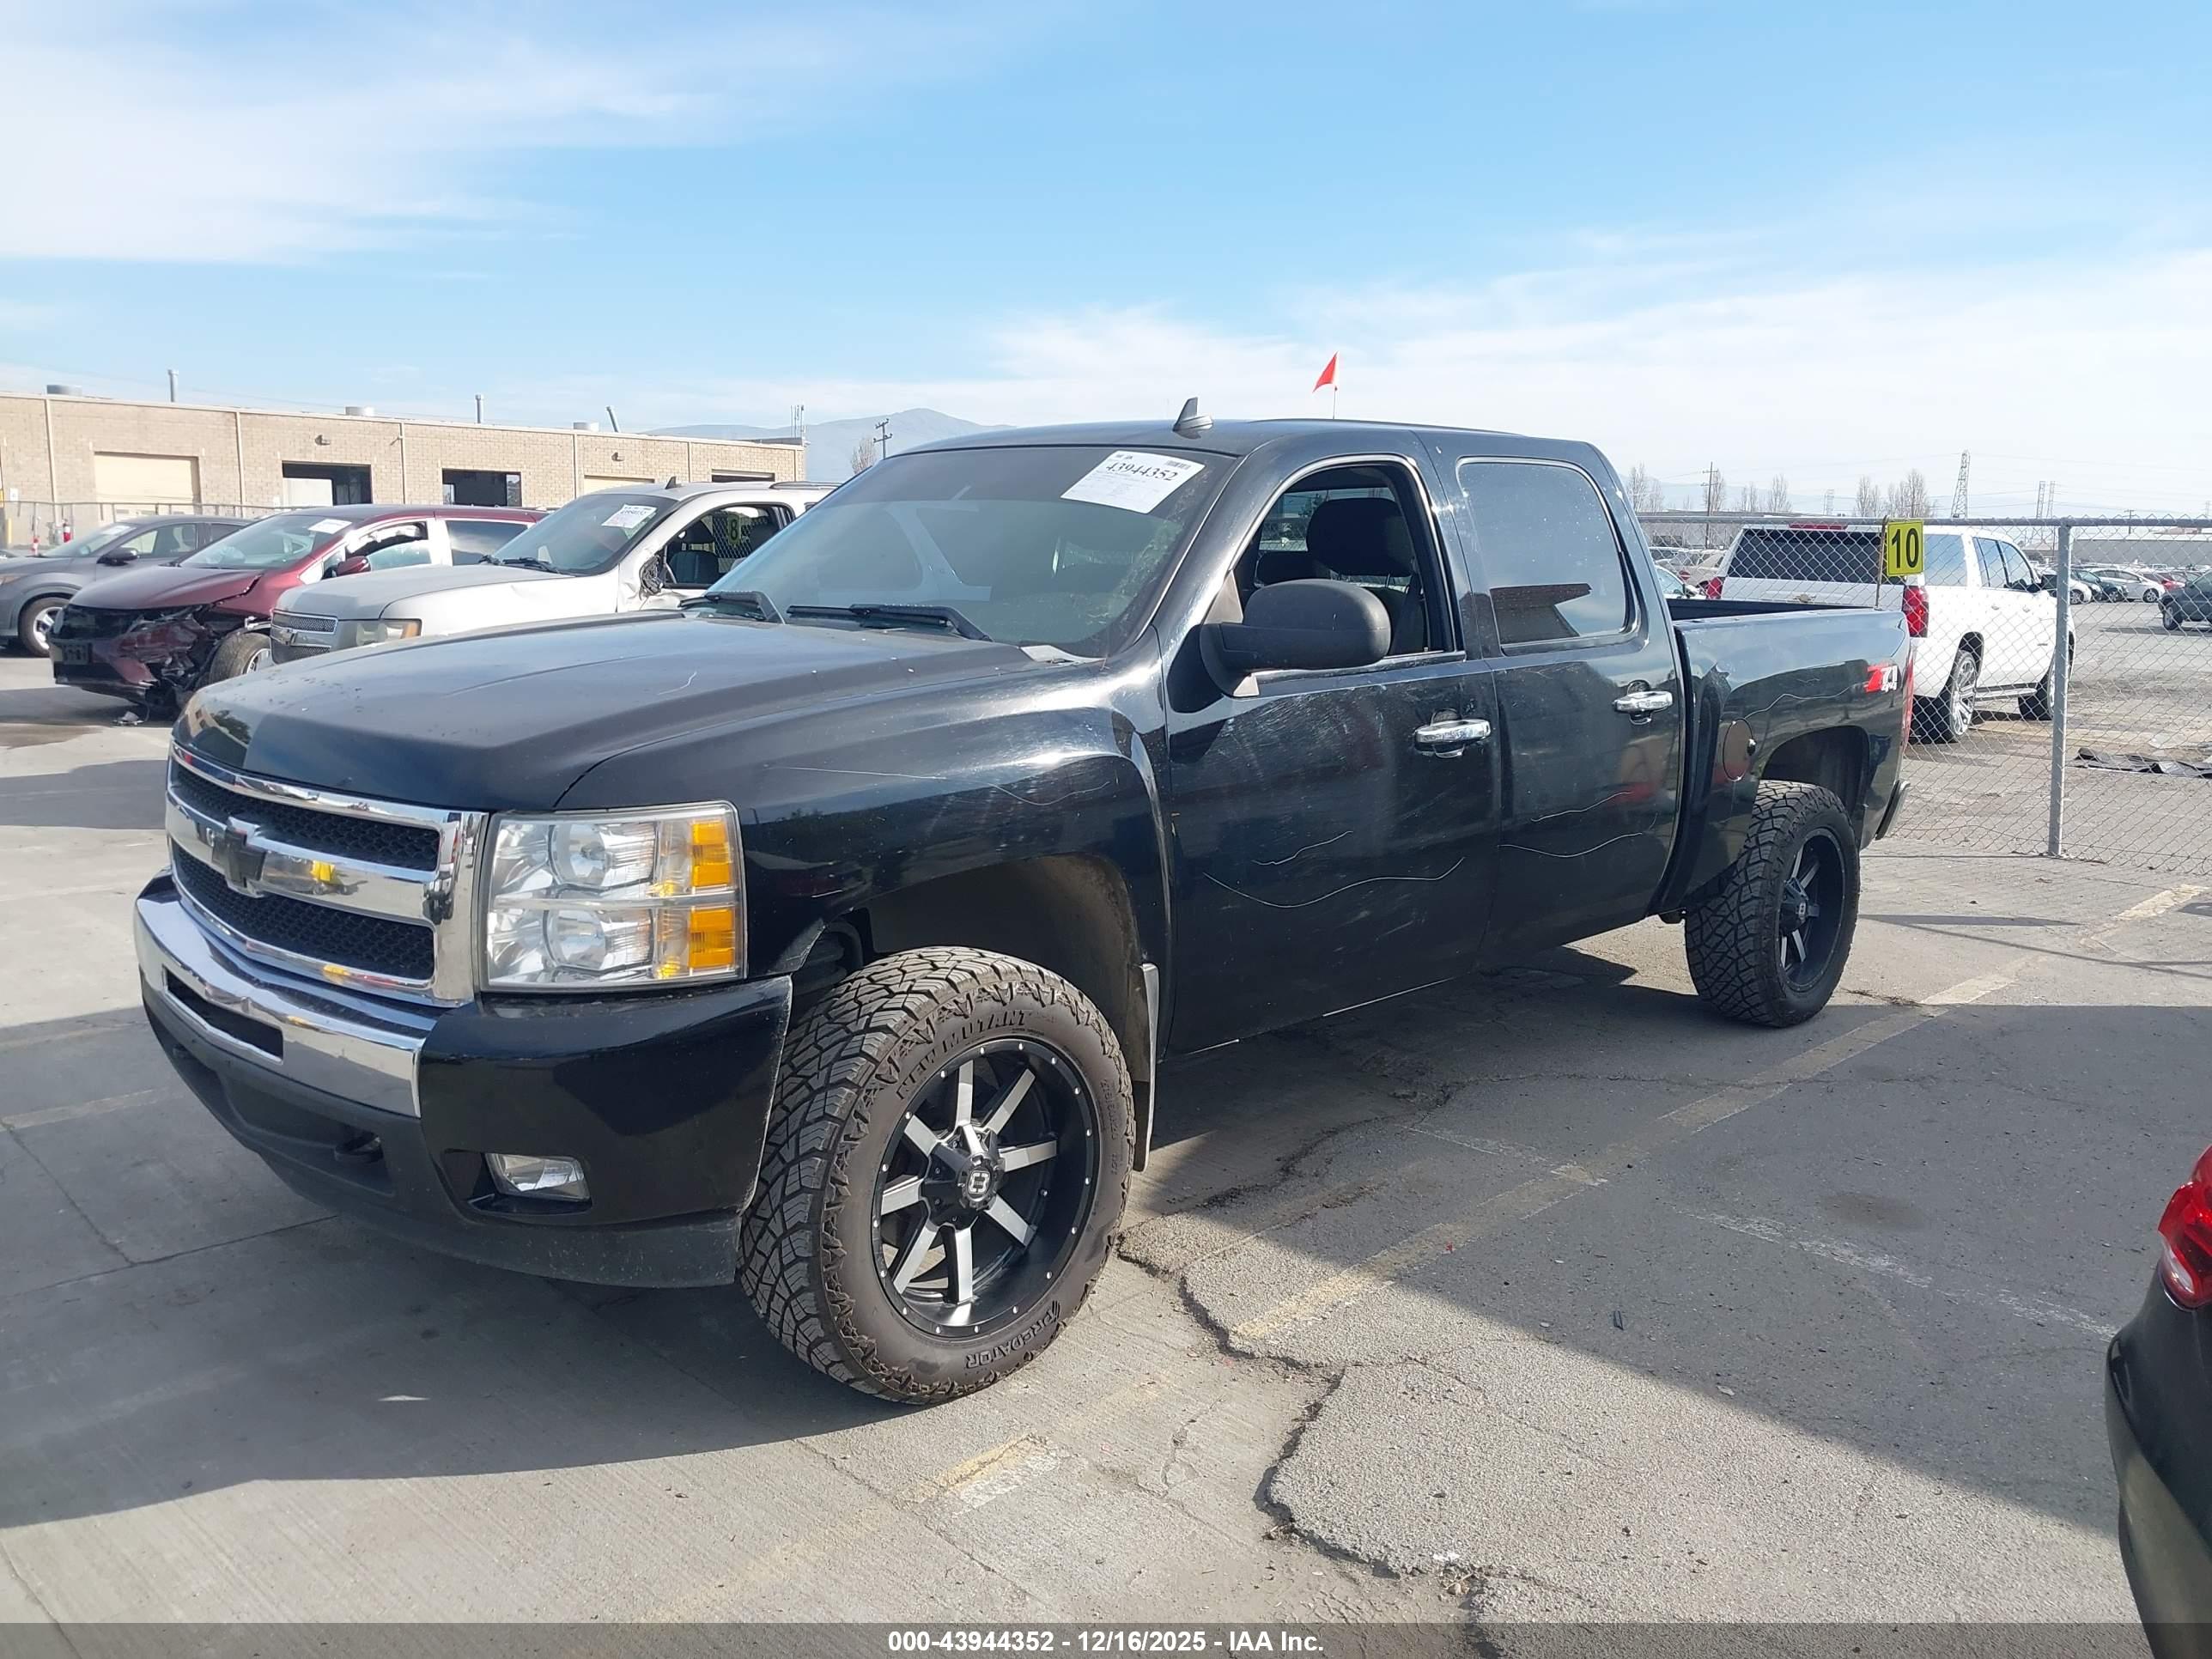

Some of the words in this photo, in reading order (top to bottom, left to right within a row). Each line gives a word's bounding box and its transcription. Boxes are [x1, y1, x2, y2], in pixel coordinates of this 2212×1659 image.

[1105, 461, 1178, 482] 43944352
[730, 519, 739, 541] 8
[1891, 527, 1920, 569] 10
[942, 1009, 1034, 1054] MUTANT
[965, 1300, 1060, 1369] PREDATOR
